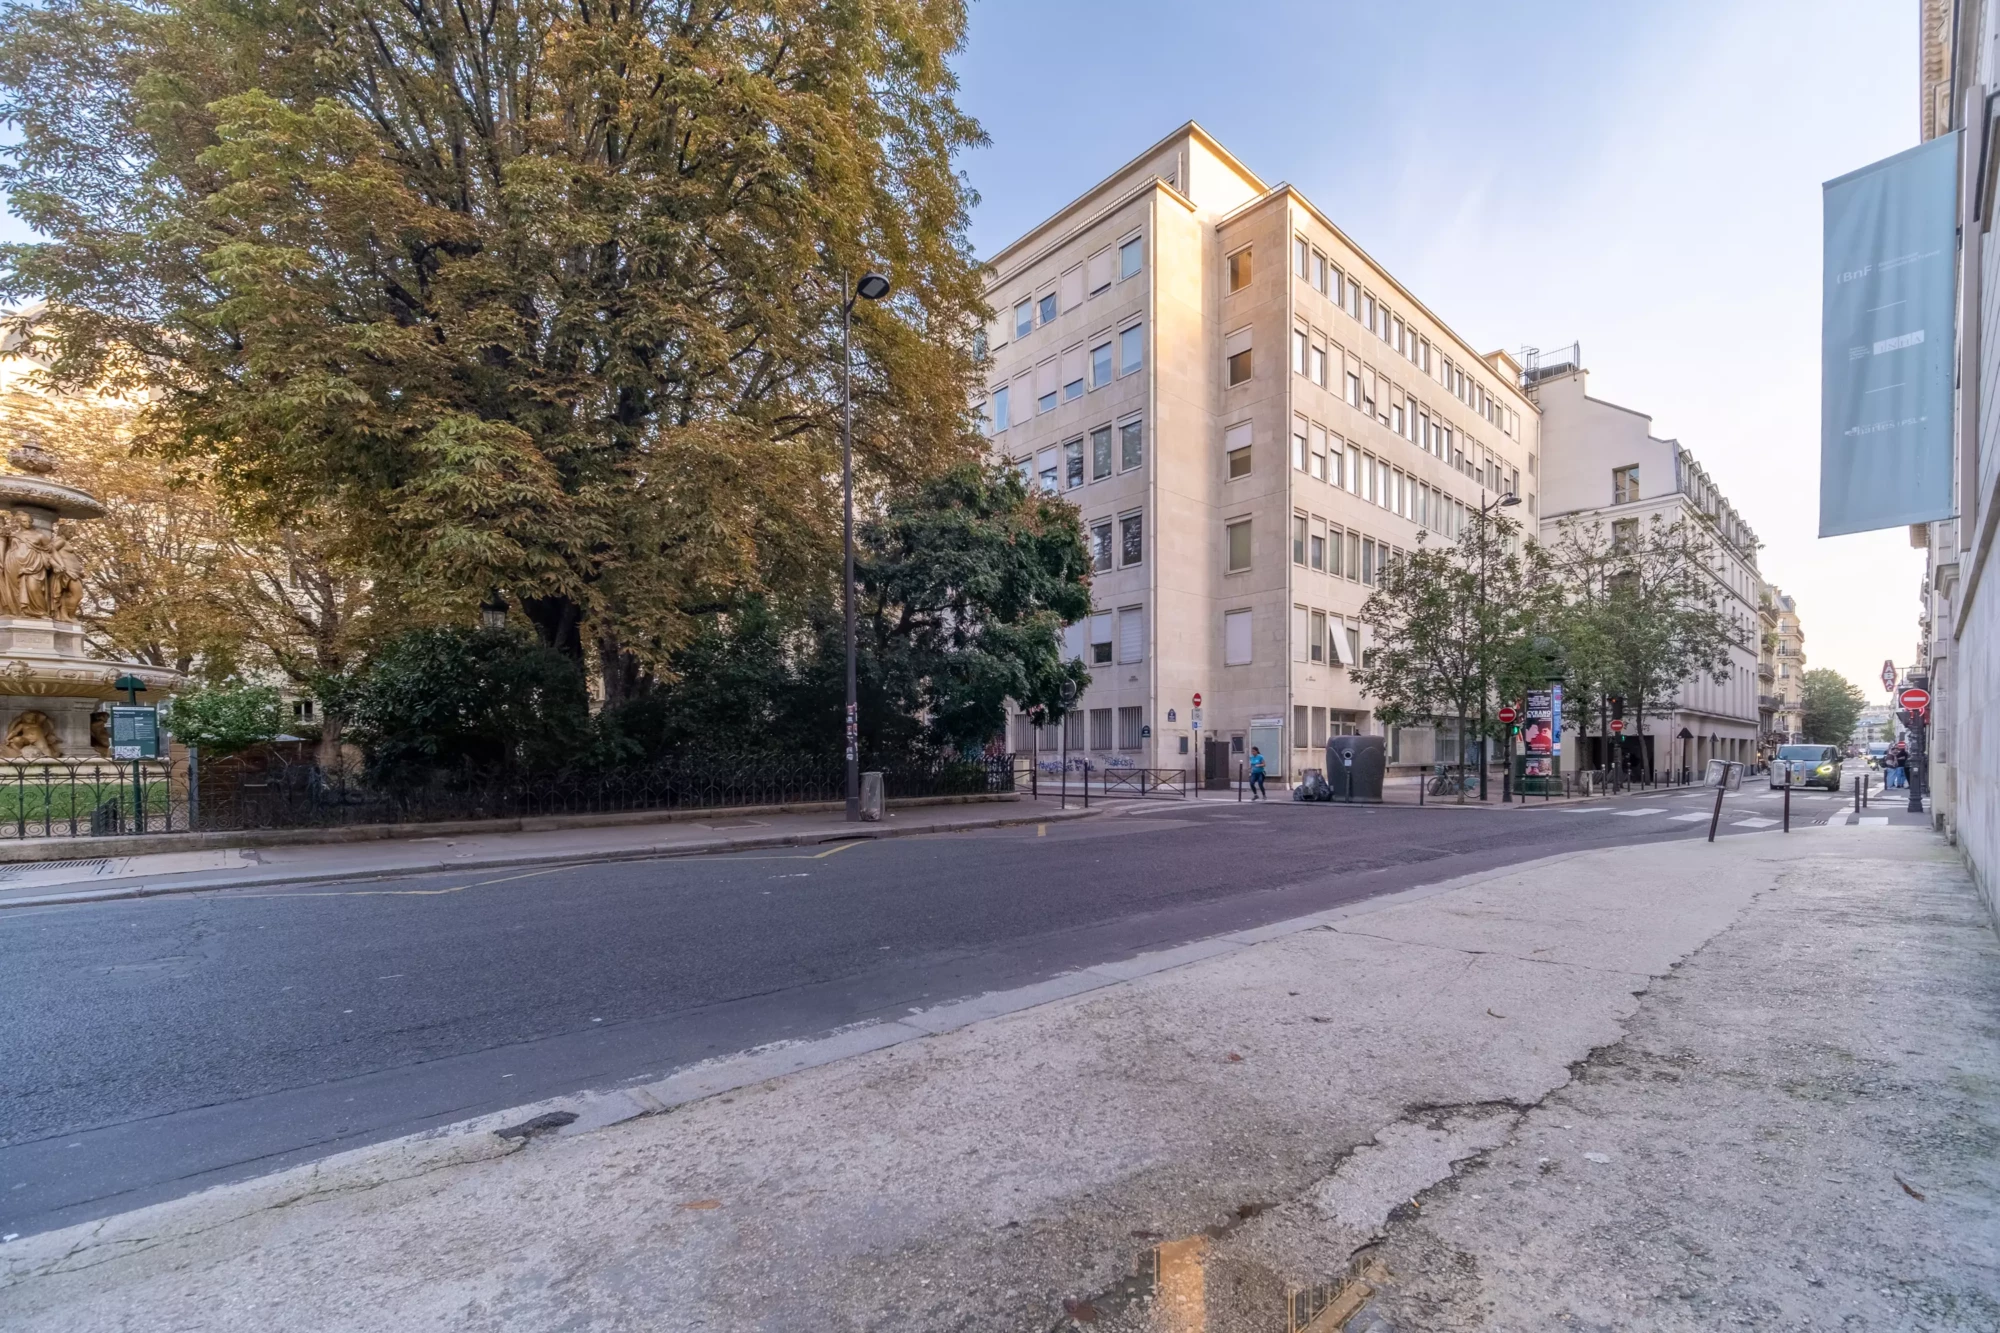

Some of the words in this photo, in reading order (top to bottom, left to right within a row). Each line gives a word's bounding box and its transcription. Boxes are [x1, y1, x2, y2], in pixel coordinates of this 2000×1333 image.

[1879, 333, 1922, 354] INHA
[1901, 416, 1918, 427] PSL
[1883, 661, 1895, 691] TABAC
